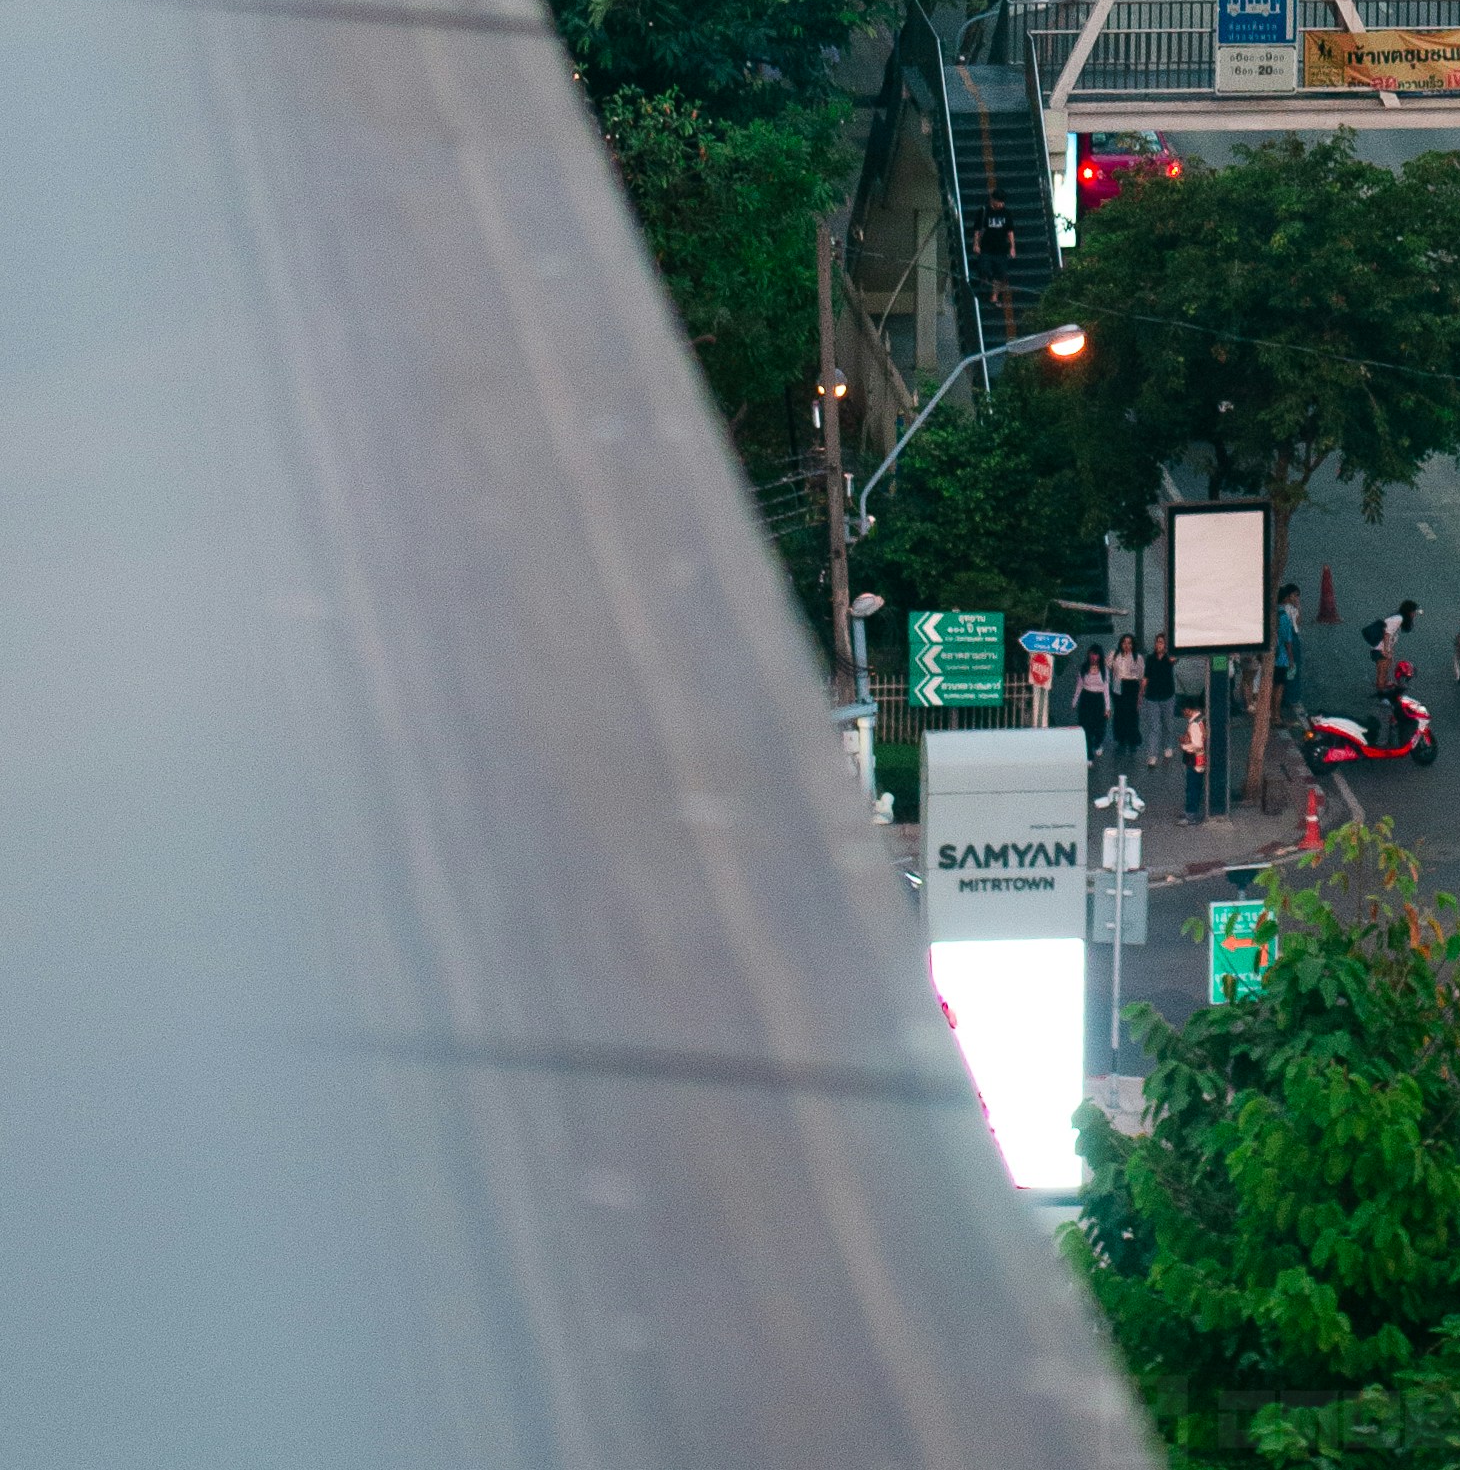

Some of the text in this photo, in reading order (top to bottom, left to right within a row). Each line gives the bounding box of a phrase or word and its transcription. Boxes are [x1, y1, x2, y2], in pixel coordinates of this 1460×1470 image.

[1052, 636, 1069, 651] 42
[938, 842, 1077, 869] SAMYAN
[959, 876, 1055, 892] MITRTOWN
